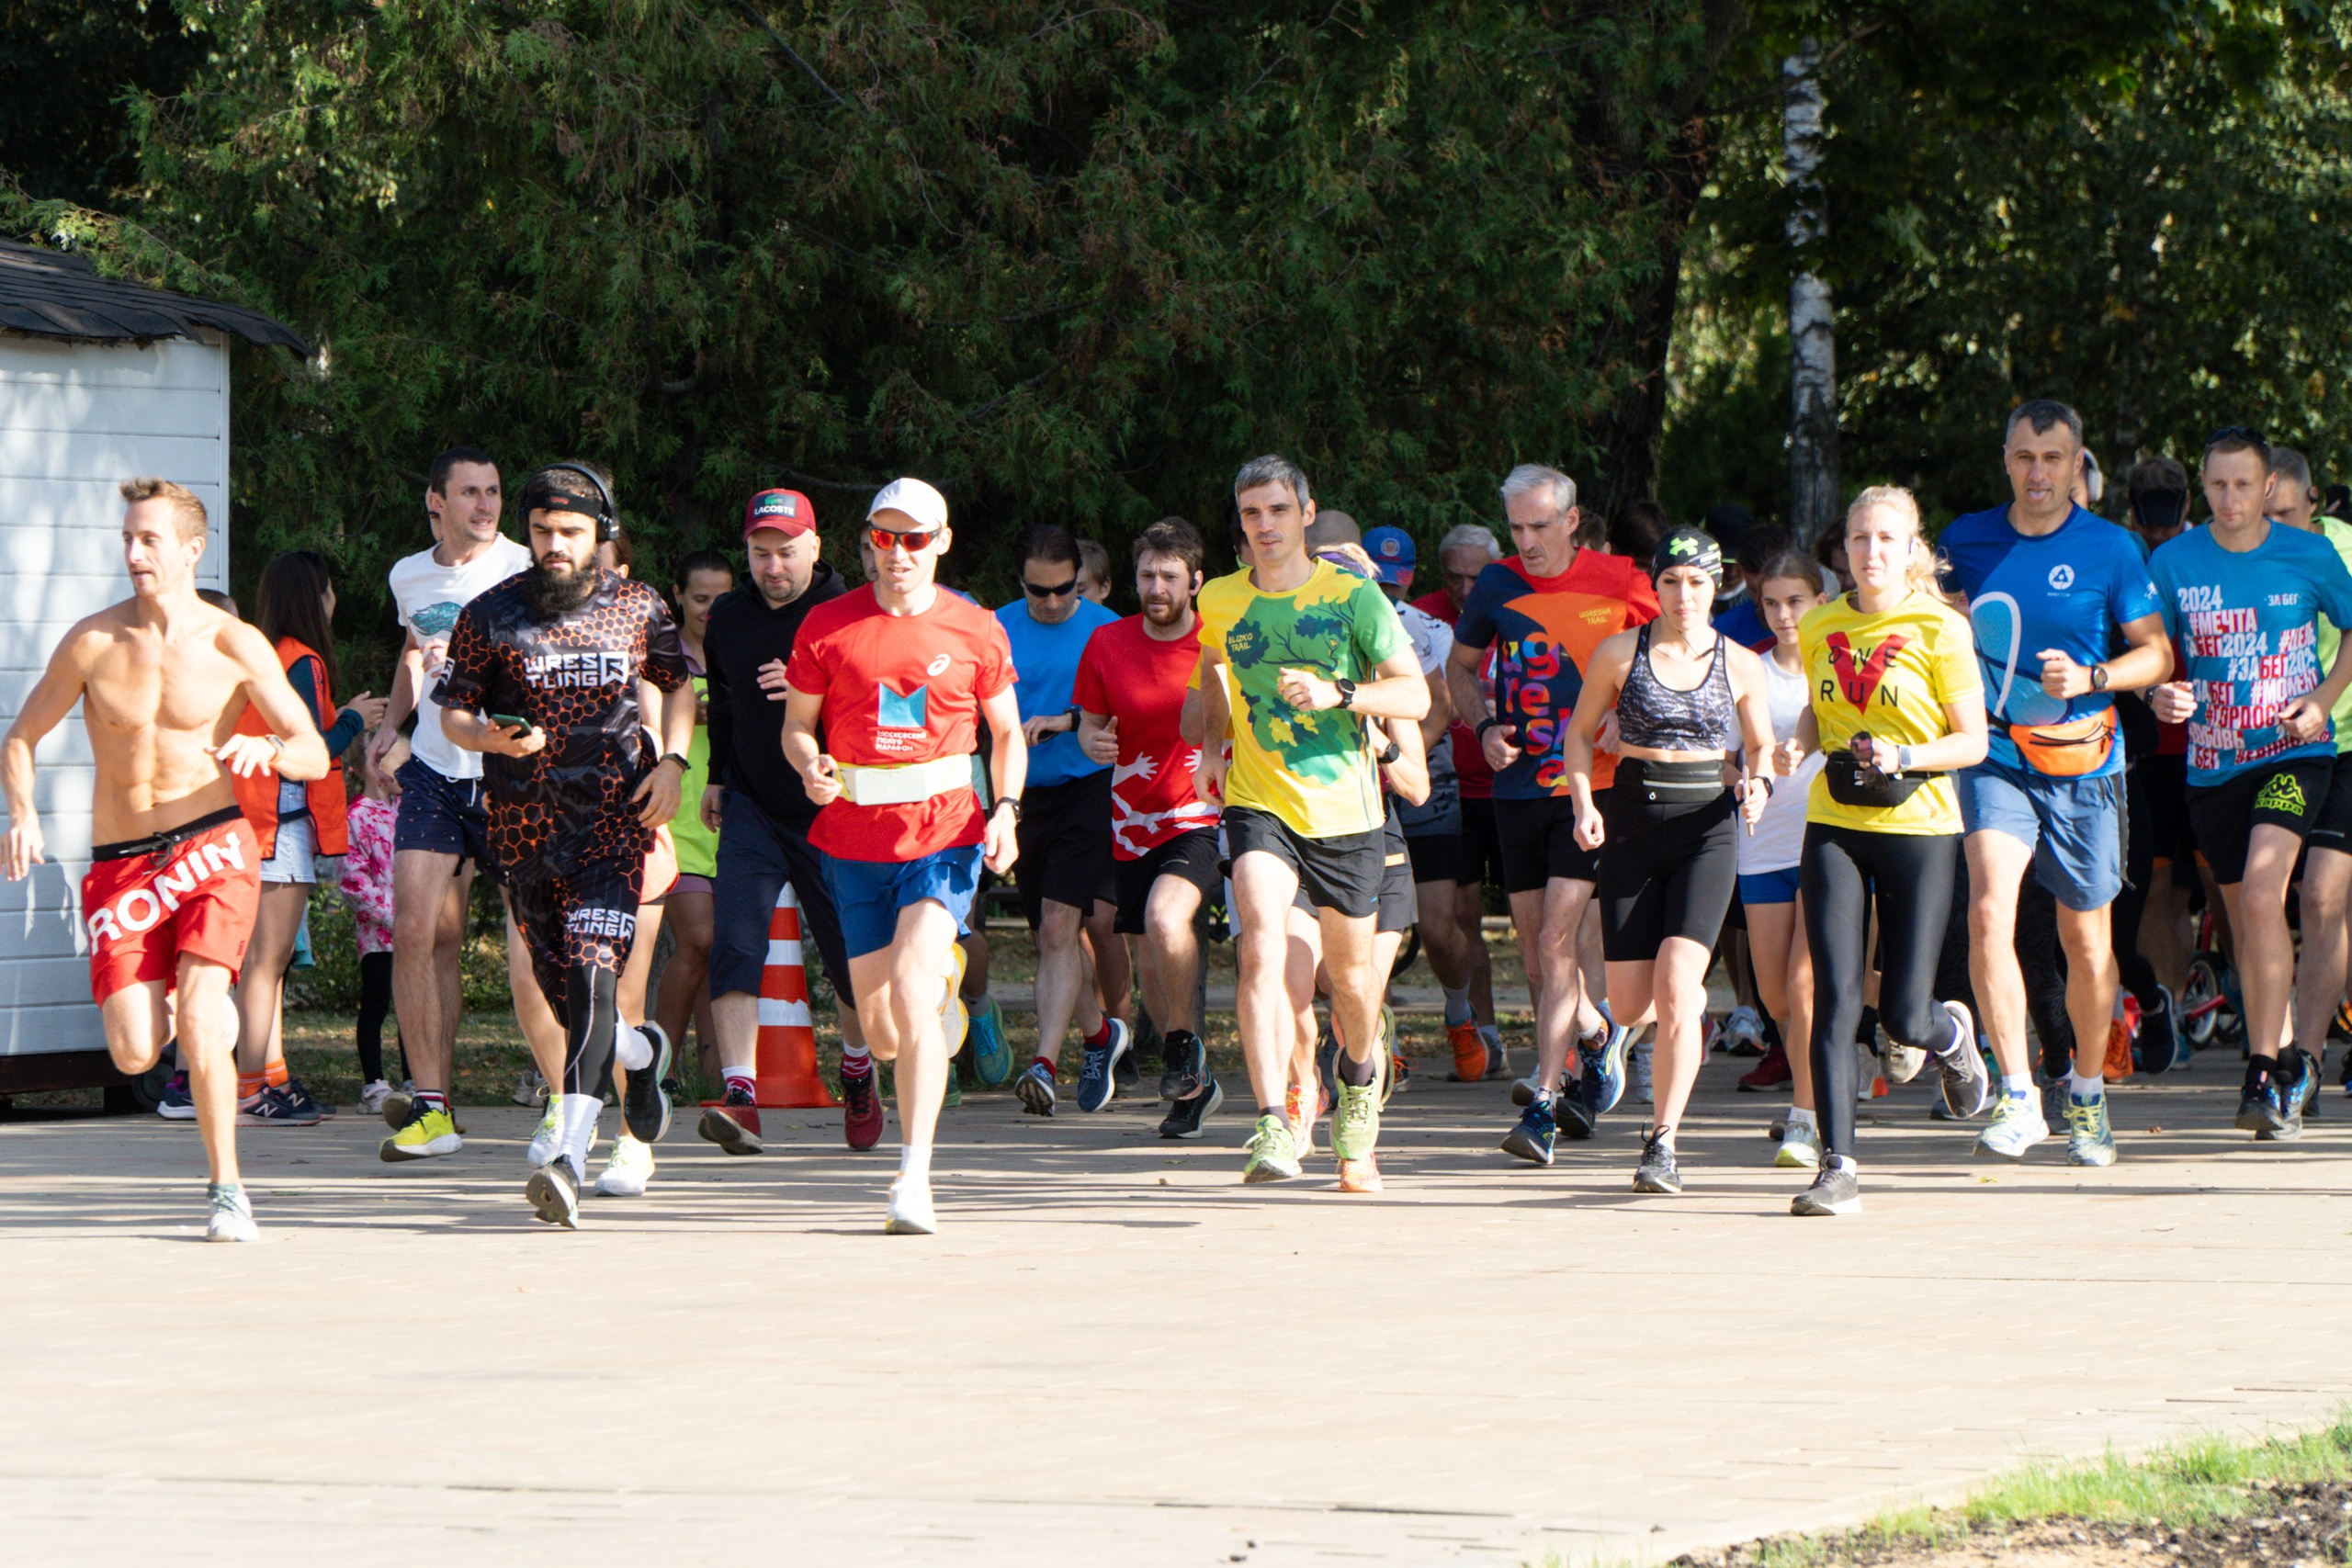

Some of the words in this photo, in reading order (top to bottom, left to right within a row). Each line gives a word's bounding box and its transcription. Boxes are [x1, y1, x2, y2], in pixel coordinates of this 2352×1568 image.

[754, 505, 795, 515] LACOSTE
[2178, 584, 2222, 612] 2024
[1578, 607, 1611, 618] UGRESHA
[1587, 615, 1608, 626] TRAIL
[2188, 607, 2257, 636] #МЕЧТА
[1228, 633, 1252, 644] BLIZKO
[1231, 642, 1251, 653] TRAIL
[524, 652, 597, 673] WRES
[1828, 646, 1898, 668] ONE
[526, 671, 597, 689] TLING
[1820, 680, 1898, 707] RUN
[87, 832, 245, 956] RONIN
[566, 908, 620, 923] WRES
[564, 921, 619, 937] TLING
